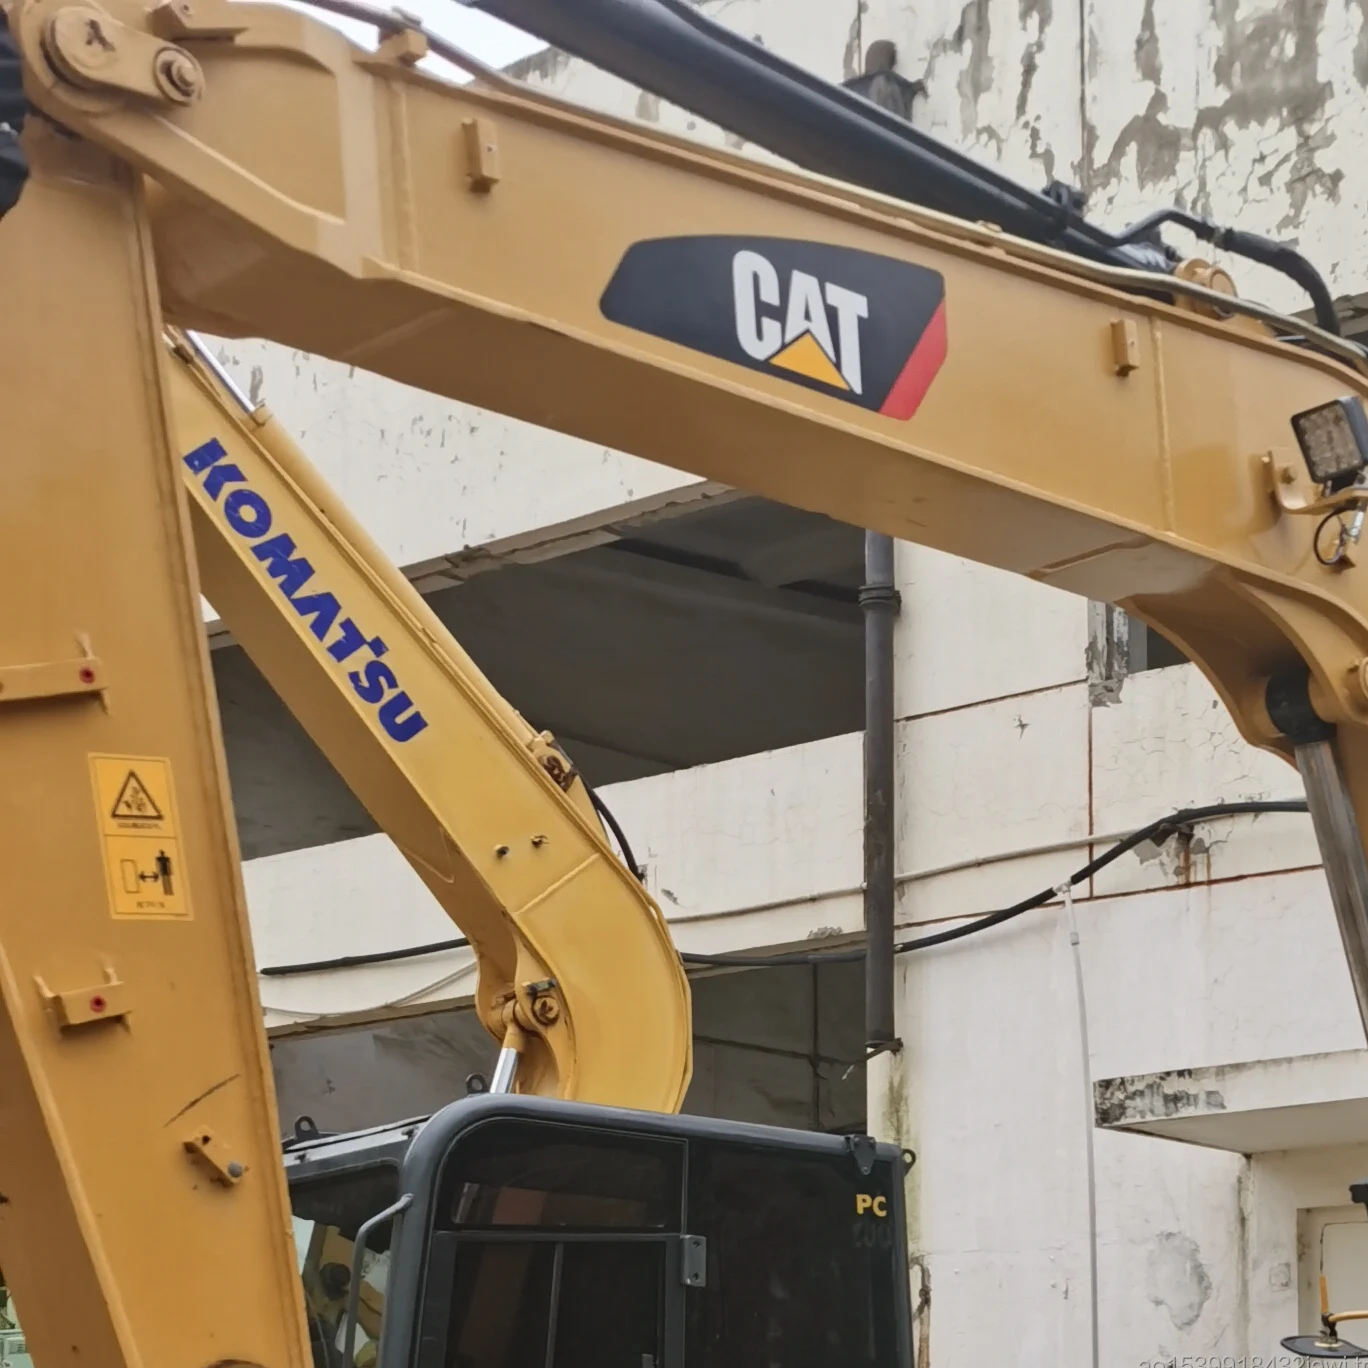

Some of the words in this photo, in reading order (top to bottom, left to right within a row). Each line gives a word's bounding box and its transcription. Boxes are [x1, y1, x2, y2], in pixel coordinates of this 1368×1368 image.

[732, 250, 869, 395] CAT
[183, 437, 429, 742] KOMATSU
[856, 1194, 887, 1217] PC
